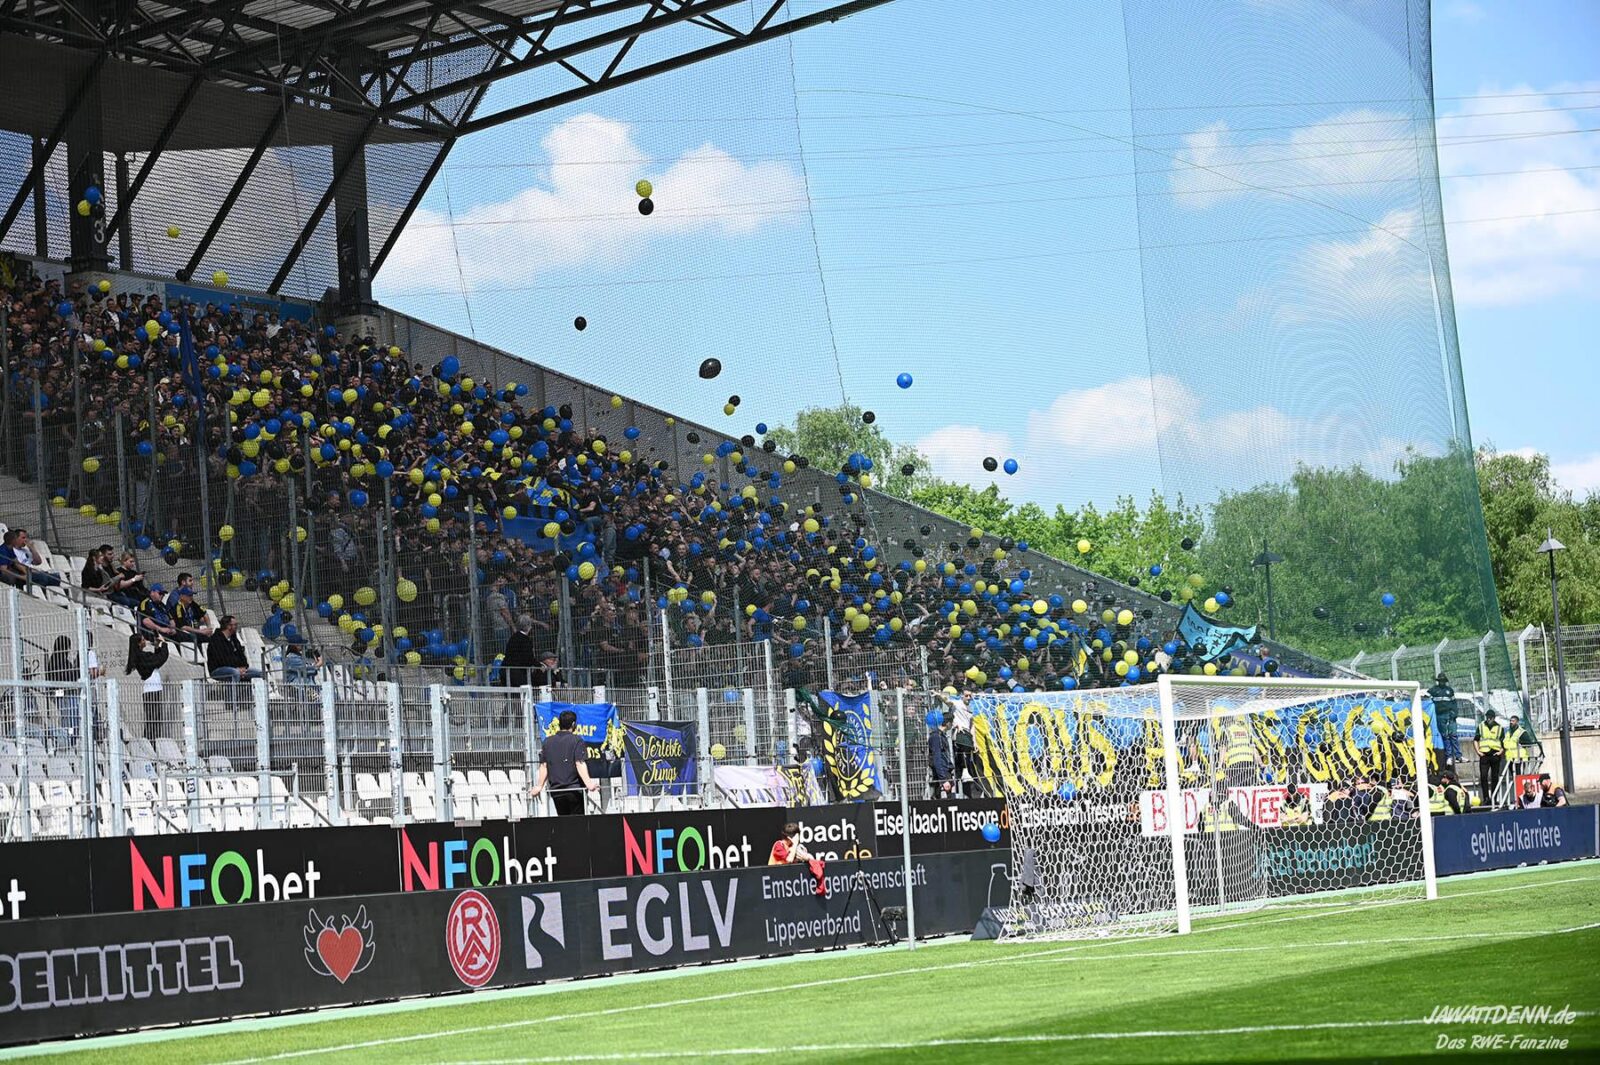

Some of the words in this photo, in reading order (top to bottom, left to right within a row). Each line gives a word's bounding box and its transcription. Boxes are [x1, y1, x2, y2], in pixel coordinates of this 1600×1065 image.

[642, 760, 678, 789] Jungs
[874, 806, 947, 836] Eisebach
[1471, 819, 1561, 862] eglv.de/karriere
[762, 864, 927, 900] Emschegenossenschaft
[598, 877, 739, 960] EGLV
[766, 910, 861, 946] Lippeverband
